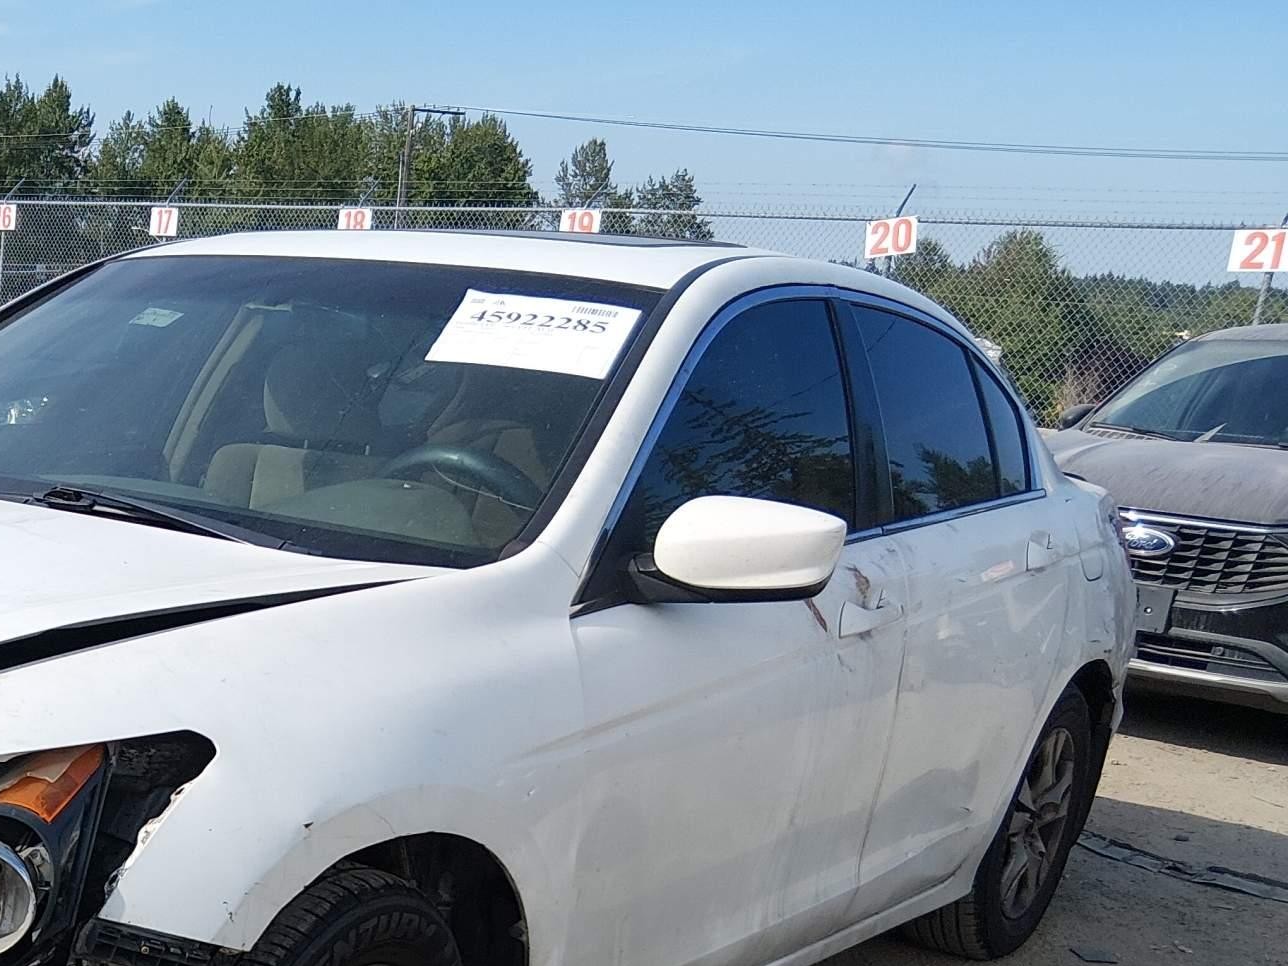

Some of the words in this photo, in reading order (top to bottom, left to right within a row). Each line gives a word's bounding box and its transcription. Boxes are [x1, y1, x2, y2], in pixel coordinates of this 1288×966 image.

[157, 209, 173, 234] 17
[344, 210, 366, 230] 18
[568, 211, 594, 233] 19
[869, 218, 912, 255] 20
[1239, 231, 1287, 270] 21
[469, 308, 610, 335] 45922285
